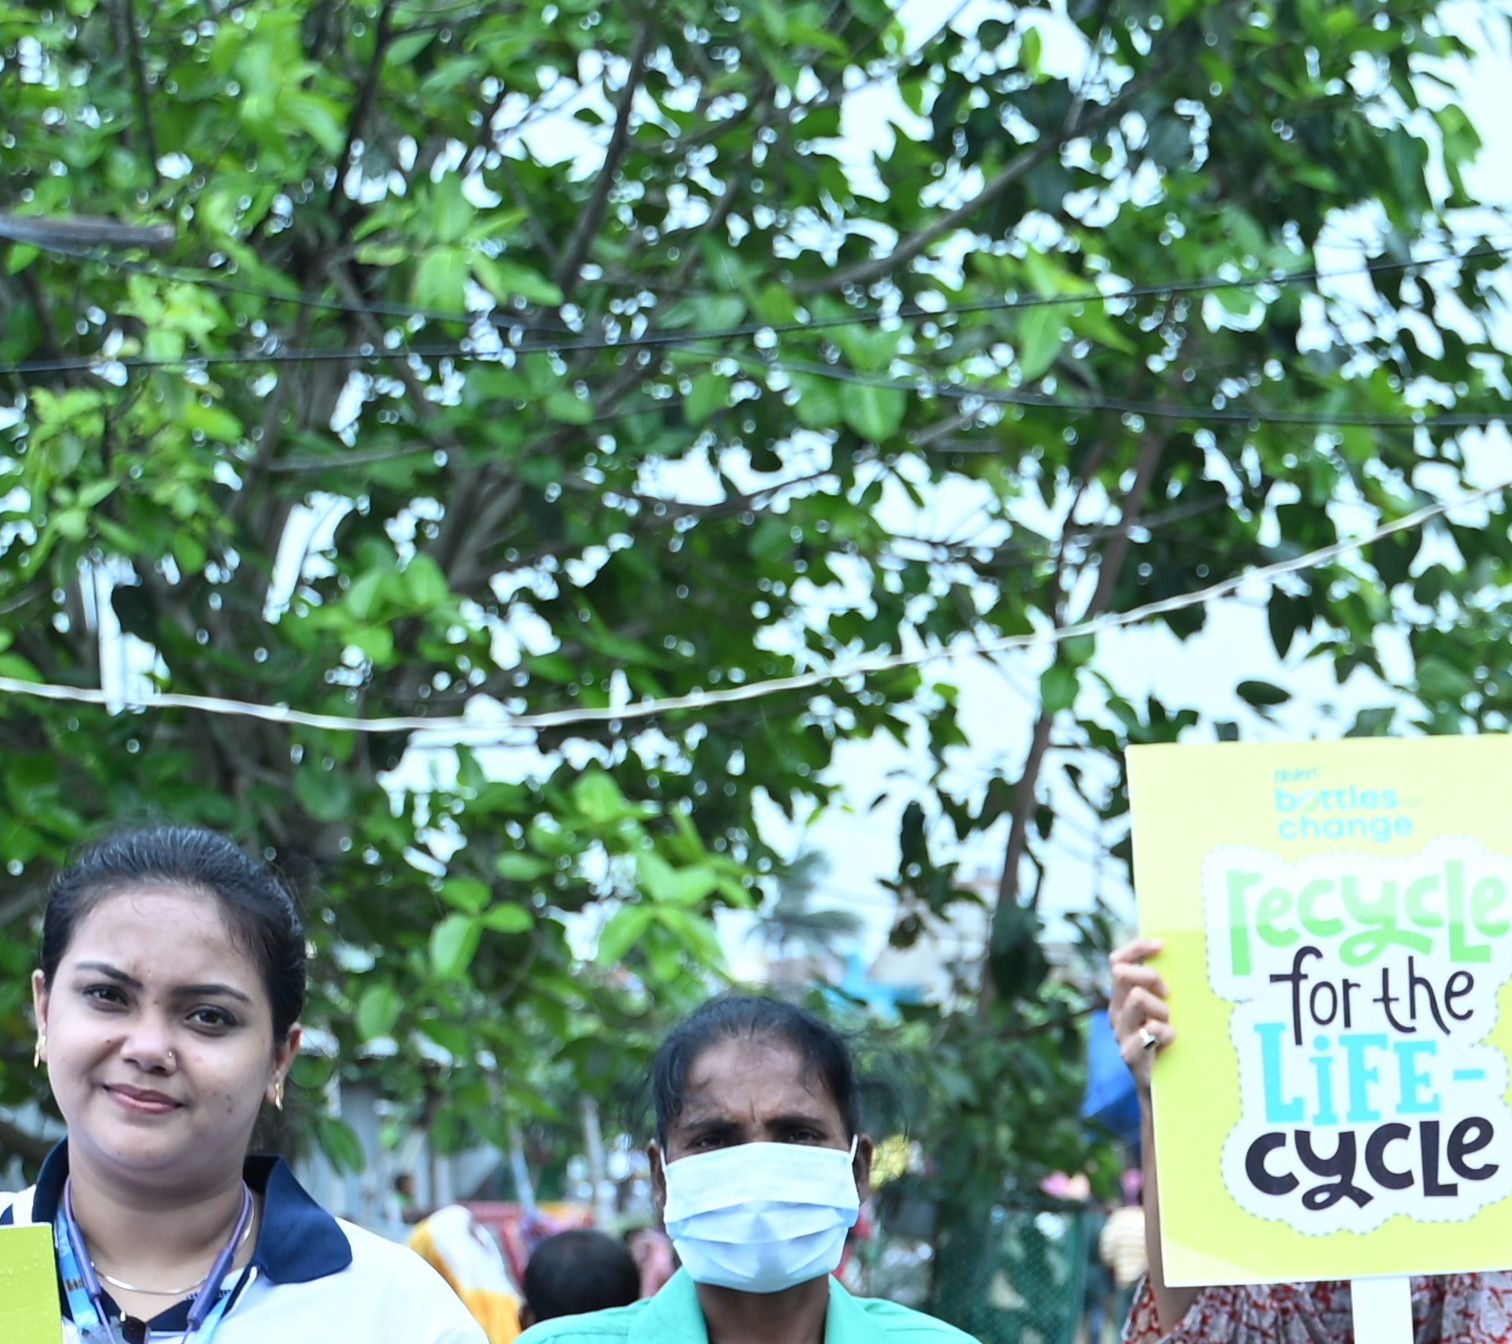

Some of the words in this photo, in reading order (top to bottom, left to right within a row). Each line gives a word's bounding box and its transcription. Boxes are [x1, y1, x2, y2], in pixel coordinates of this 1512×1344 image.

[1275, 784, 1398, 812] bottles
[1278, 815, 1414, 844] change
[1226, 860, 1510, 976] recycle
[1269, 945, 1362, 1046] for
[1373, 956, 1475, 1036] the
[1245, 1116, 1499, 1211] cycle
